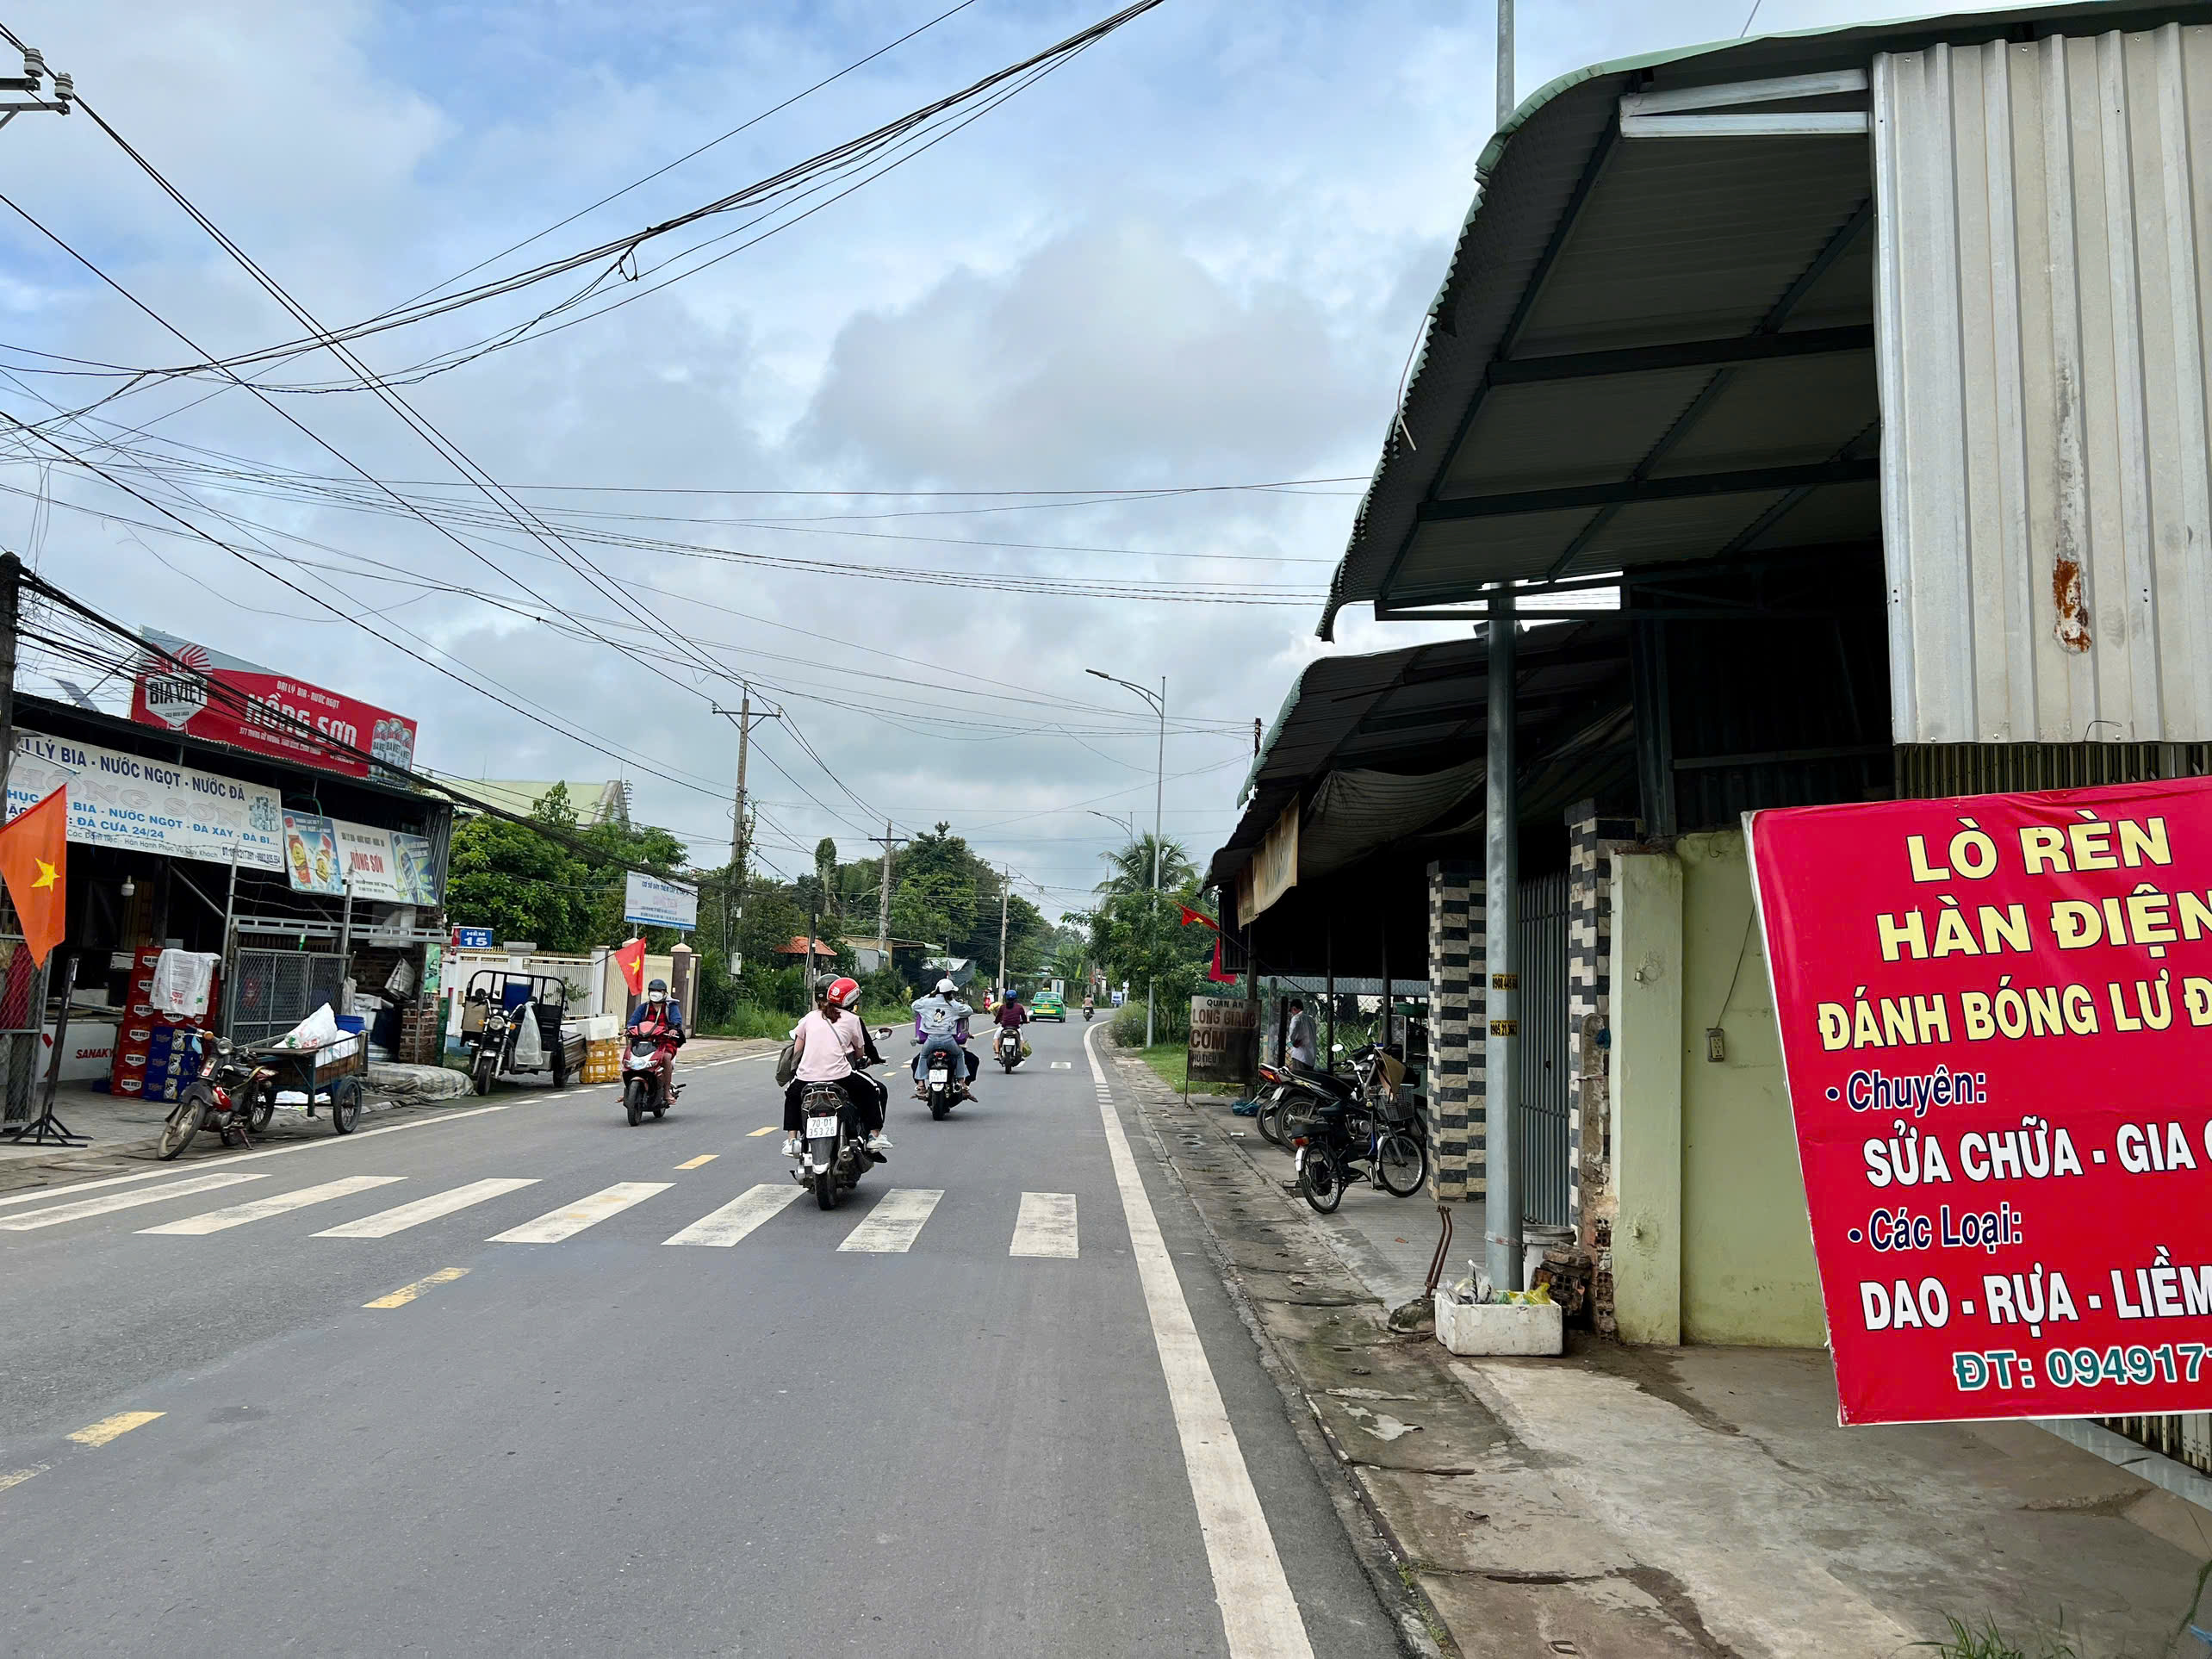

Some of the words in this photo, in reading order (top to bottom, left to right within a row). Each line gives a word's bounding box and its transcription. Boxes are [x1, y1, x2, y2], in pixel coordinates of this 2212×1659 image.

[150, 681, 173, 705] BIA
[245, 693, 310, 739] HỒNG
[36, 739, 55, 760] LÝ
[61, 747, 87, 767] BIA
[100, 756, 140, 779] NƯỚC
[145, 765, 180, 790] NGỌT
[192, 777, 226, 798] NƯỚC
[229, 784, 245, 802] ĐÁ
[7, 790, 40, 804] HỤC
[73, 801, 96, 814] BIA
[109, 808, 145, 823] NƯỚC
[149, 815, 183, 830] NGỌT
[192, 823, 208, 834] ĐÁ
[212, 827, 233, 838] XAY
[243, 832, 257, 842] ĐÁ
[78, 816, 96, 828] ĐÁ
[100, 820, 127, 833] CƯA
[133, 826, 165, 839] 24/24
[1906, 817, 1998, 883] LÒ
[2018, 809, 2172, 876] RÈN
[464, 936, 488, 947] 15
[1876, 895, 2034, 962] HÀN
[2049, 882, 2212, 959] ĐIỆN
[1192, 1009, 1221, 1025] LONG
[1224, 1010, 1257, 1028] GIANG
[1817, 985, 1952, 1052] ĐÁNH
[1960, 974, 2100, 1041] BÓNG
[2107, 968, 2173, 1033] LƯ
[1190, 1027, 1227, 1050] CƠM
[1848, 1065, 1987, 1117] Chuyên:
[1862, 1119, 1954, 1188] SỬA
[1960, 1115, 2084, 1183] CHỮA
[2116, 1121, 2197, 1175] GIA
[1869, 1209, 1932, 1252] Các
[1940, 1202, 2022, 1253] Loại:
[1859, 1276, 1950, 1332] DAO
[1983, 1262, 2079, 1338] RỰA
[2110, 1246, 2212, 1320] LIỀM
[1953, 1350, 2035, 1392] ĐT:
[2046, 1344, 2212, 1388] 094917
